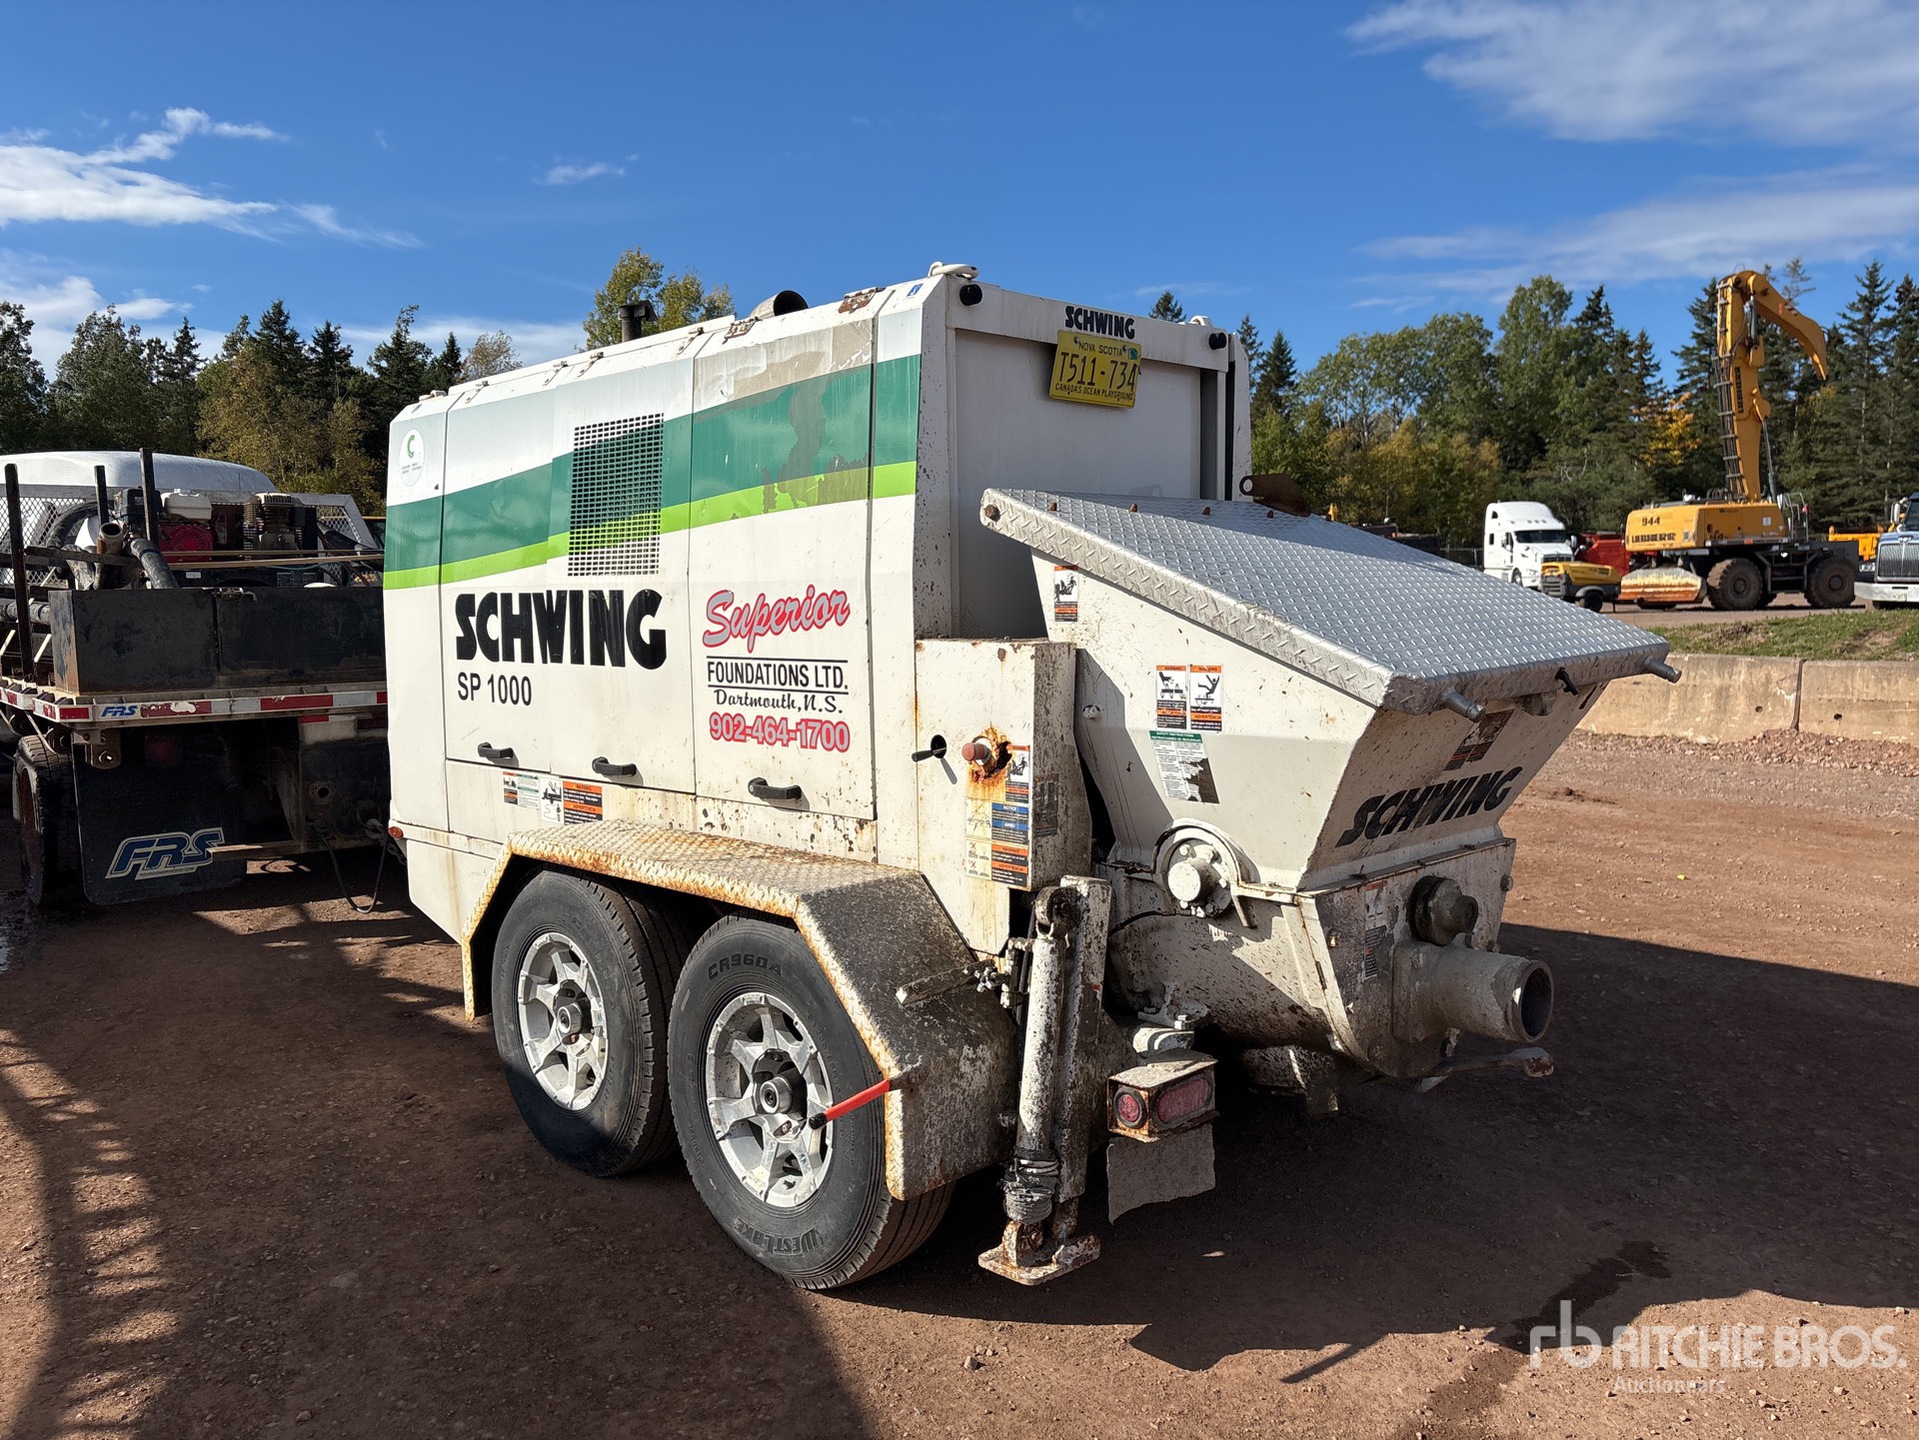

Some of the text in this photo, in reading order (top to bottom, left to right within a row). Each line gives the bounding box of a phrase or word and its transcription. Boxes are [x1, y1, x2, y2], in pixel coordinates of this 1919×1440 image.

[1065, 306, 1135, 339] SCHWING
[1079, 342, 1122, 356] NOVA SCOTIA
[1055, 383, 1083, 394] CANADA'S
[1083, 387, 1101, 396] OCEAN
[1642, 516, 1661, 527] 944
[455, 588, 667, 670] SCHWING
[702, 584, 851, 653] Superior
[458, 671, 532, 706] SP 1000
[707, 661, 848, 690] FOUNDATIONS LTD.
[101, 705, 138, 718] FRS
[714, 689, 843, 714] Dartmouth, N.S.
[709, 711, 851, 753] 902-464-1700
[1335, 766, 1523, 848] SCHWING
[108, 829, 224, 877] FRS
[707, 952, 782, 980] CR960A
[733, 1217, 825, 1255] WESTLAKE
